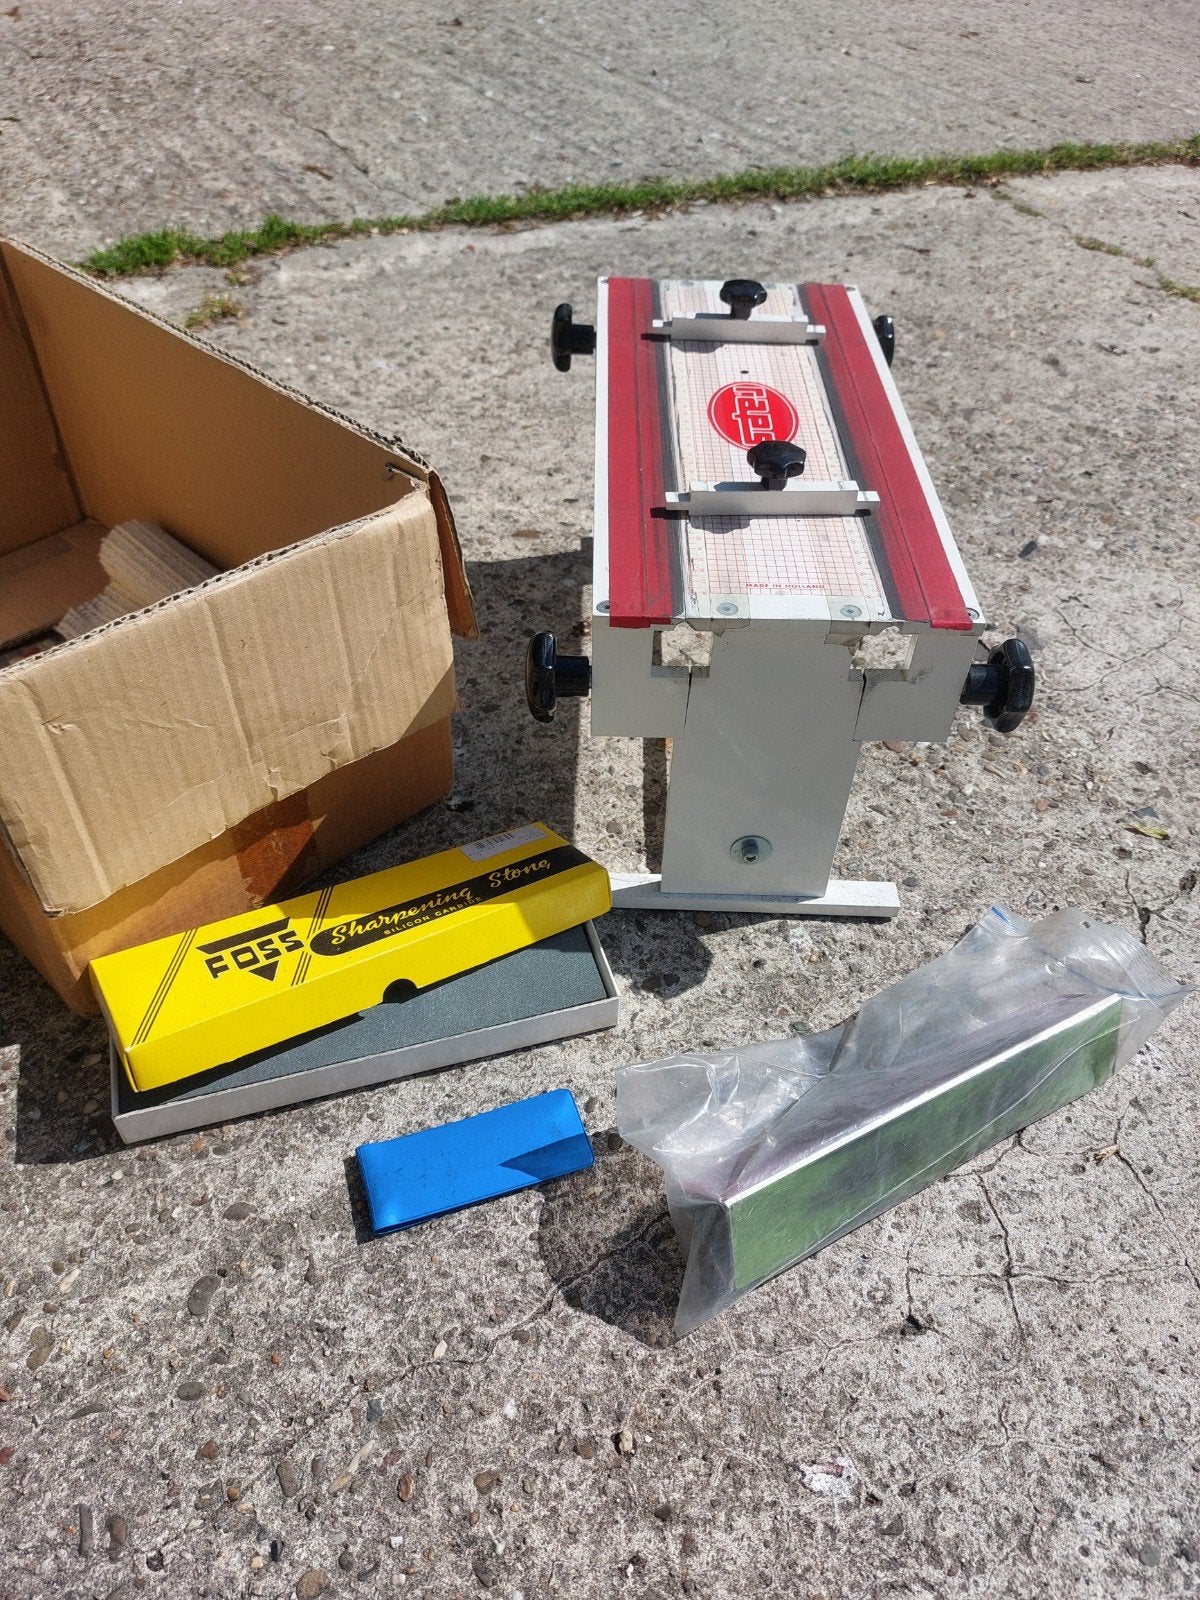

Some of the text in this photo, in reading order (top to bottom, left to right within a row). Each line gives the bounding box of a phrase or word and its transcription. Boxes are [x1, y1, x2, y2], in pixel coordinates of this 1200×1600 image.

[331, 858, 551, 945] Sharpening Stone
[383, 896, 483, 936] SILICON CARBIDE
[204, 929, 305, 979] FOSS
